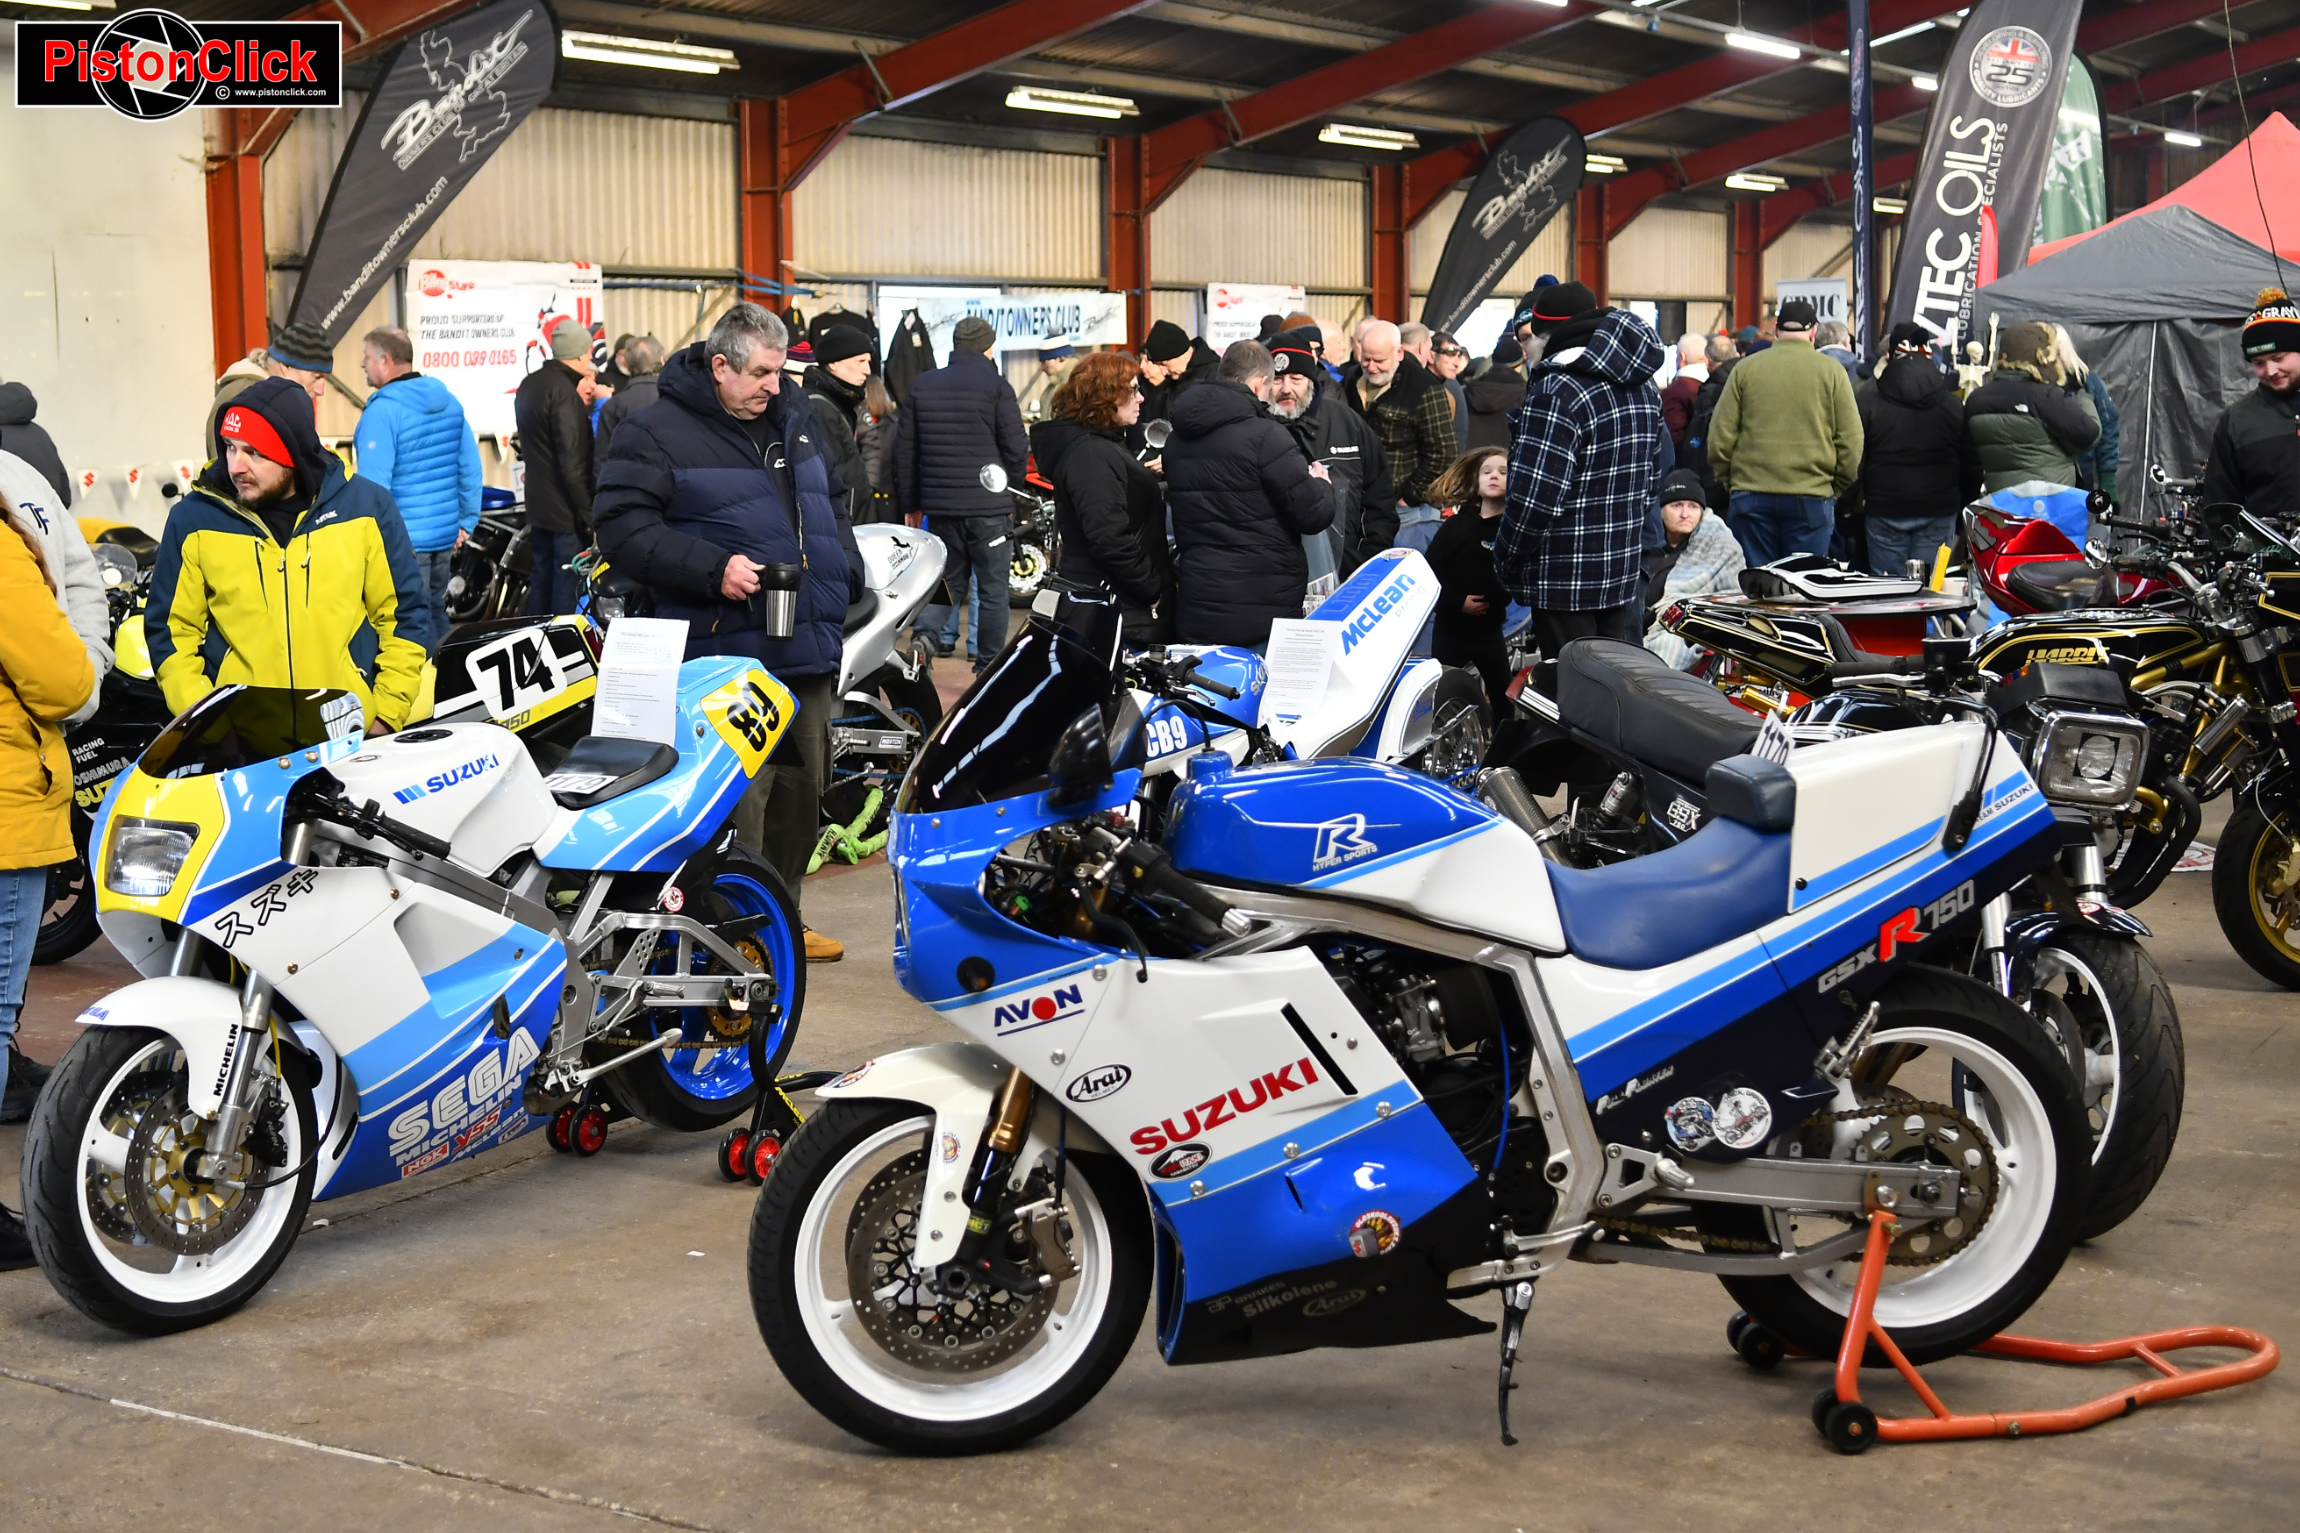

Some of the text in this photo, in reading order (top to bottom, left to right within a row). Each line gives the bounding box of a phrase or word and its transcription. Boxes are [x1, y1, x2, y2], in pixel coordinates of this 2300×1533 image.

[1985, 62, 2036, 87] 25
[1935, 114, 1997, 217] OILS
[422, 351, 460, 369] 0800
[475, 636, 556, 712] 74
[726, 681, 781, 753] 89
[71, 737, 106, 758] RACING
[75, 750, 99, 764] FUEL
[73, 756, 131, 786] OSHIMURA
[425, 753, 500, 794] SUZUKI
[1993, 783, 2034, 811] SUZUKI
[1312, 844, 1378, 872] HYPER SPORTS
[214, 868, 319, 949] スズキ
[1818, 879, 1975, 994] GSX R 750
[212, 1023, 239, 1098] MICHELIN
[387, 1026, 541, 1158] SEGA
[1072, 1065, 1124, 1101] Arai
[396, 1073, 523, 1168] MICHELIN
[1129, 1056, 1320, 1156] SUZUKI
[407, 1147, 444, 1174] NGK
